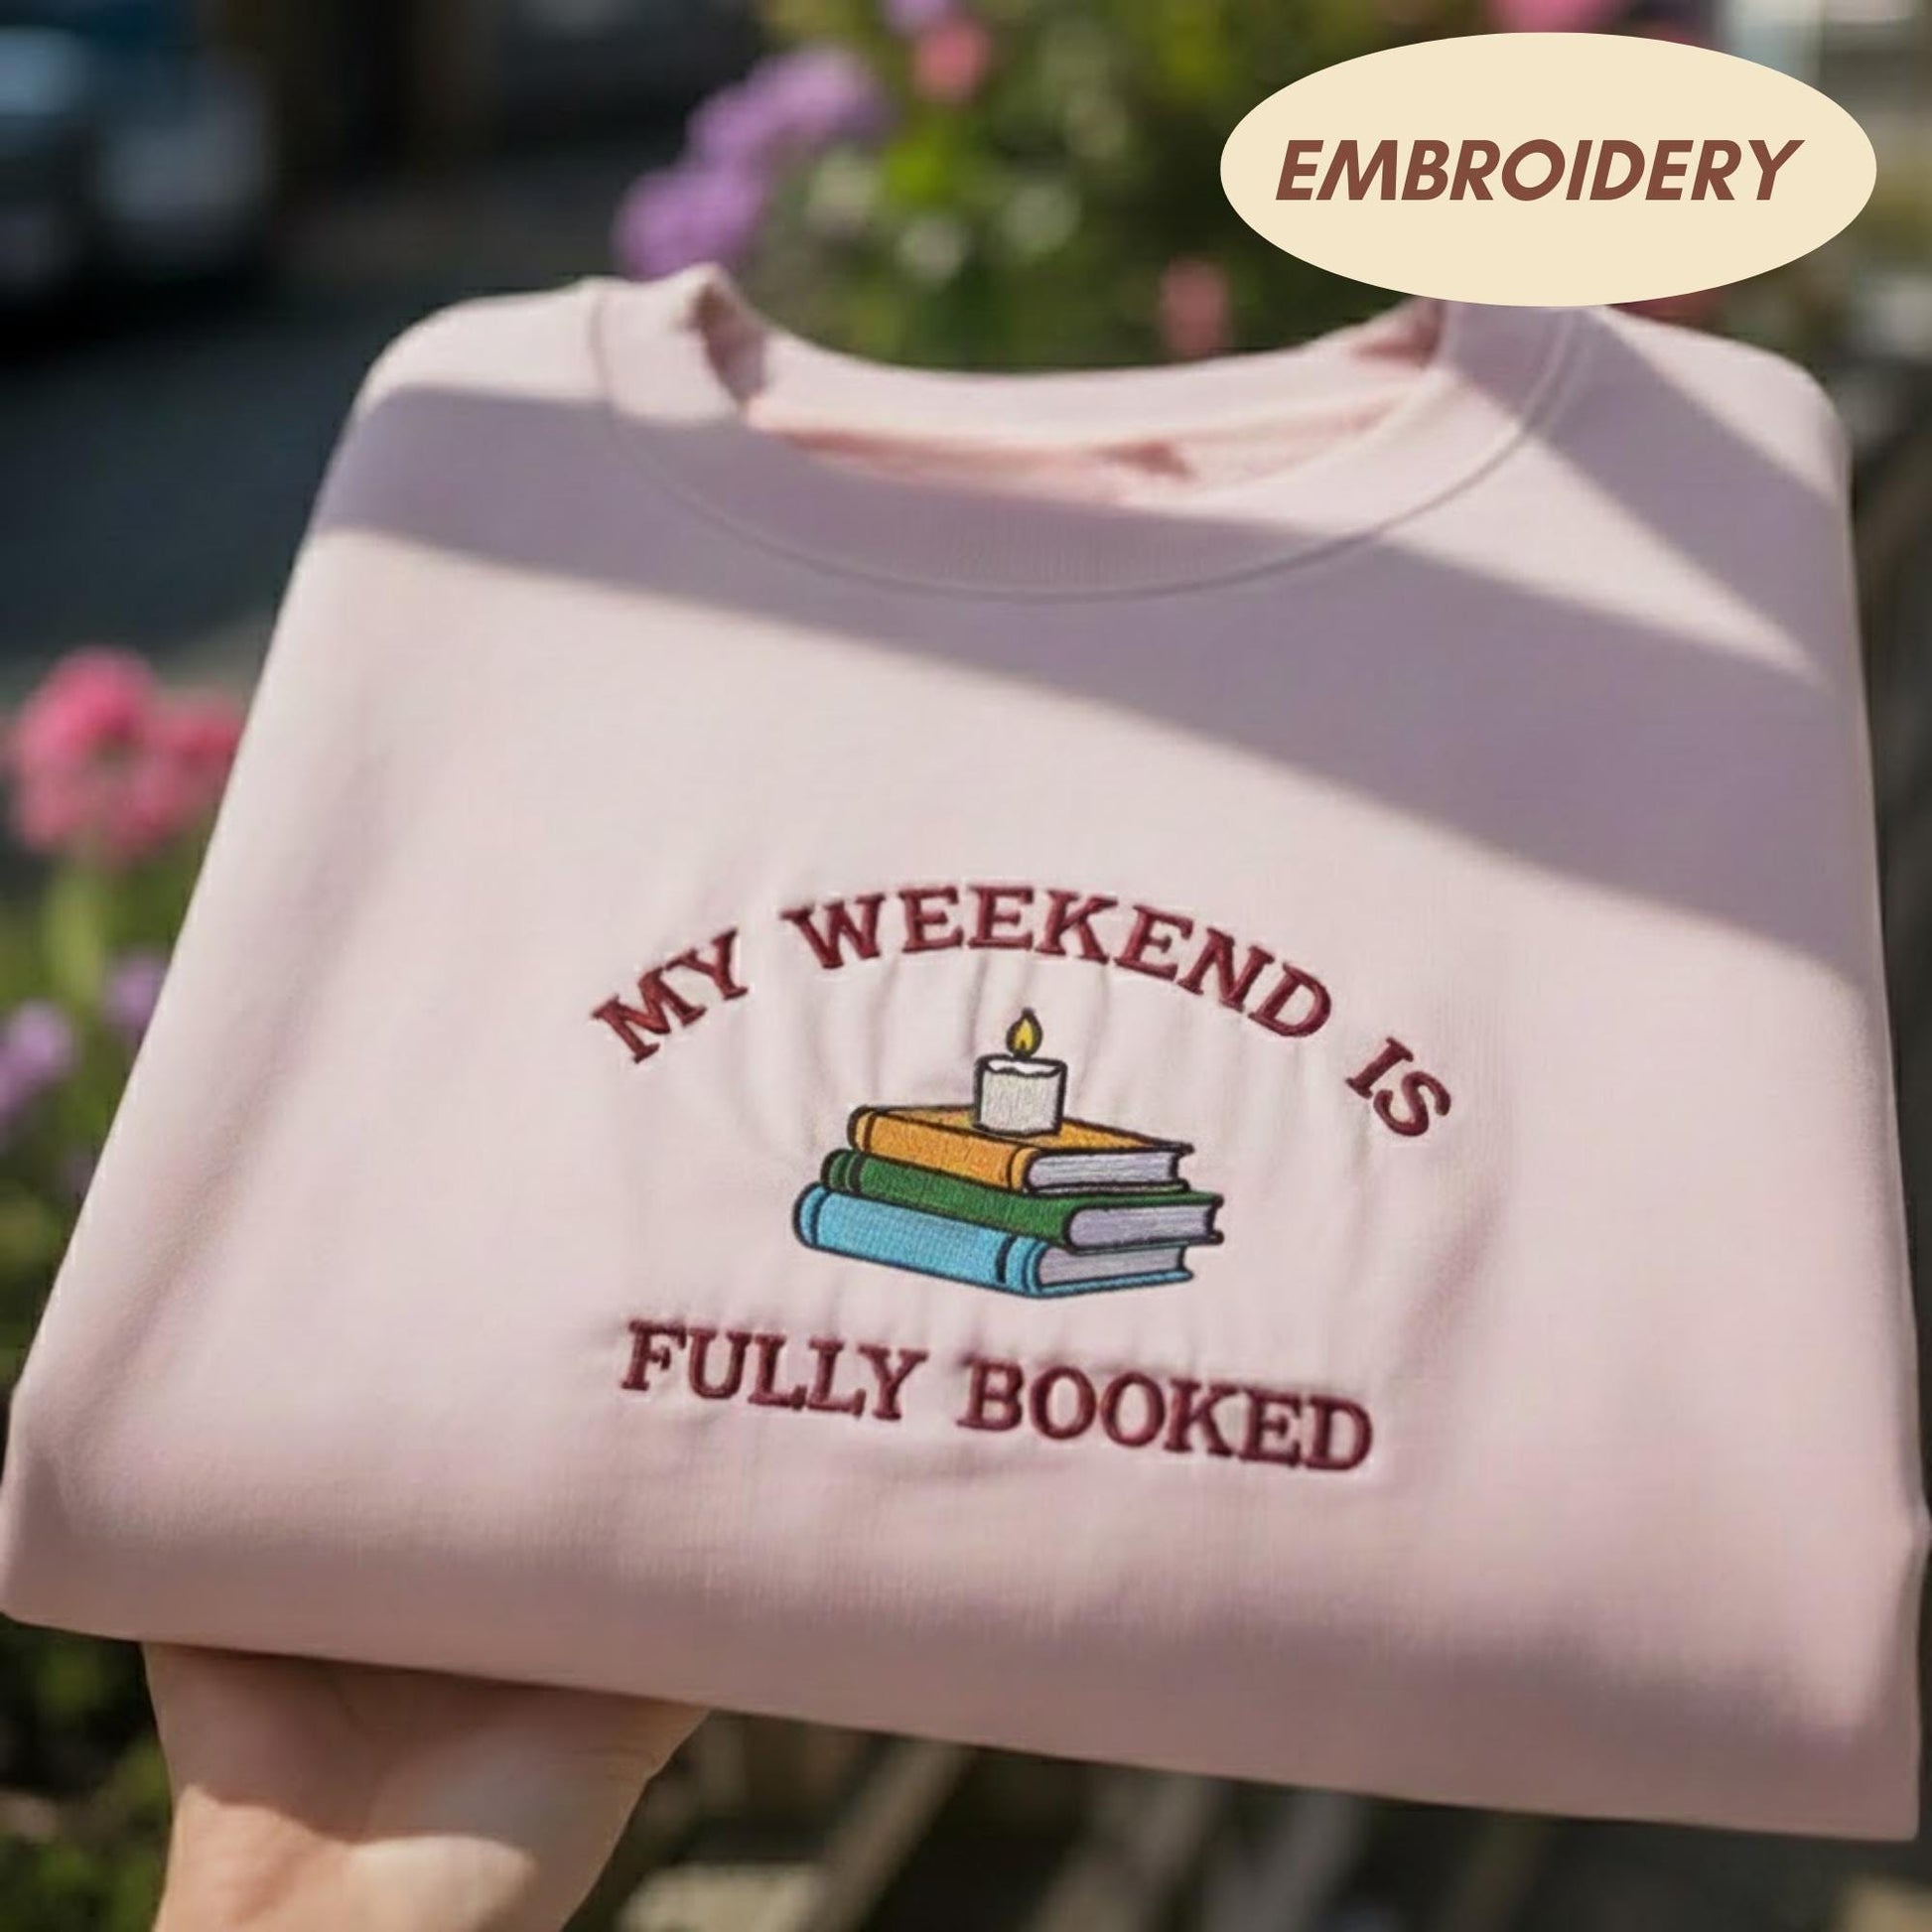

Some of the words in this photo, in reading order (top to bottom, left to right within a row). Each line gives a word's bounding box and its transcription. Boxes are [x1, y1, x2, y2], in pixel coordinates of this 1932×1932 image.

[592, 928, 750, 1063] MY
[782, 885, 1332, 1038] WEEKEND
[1346, 1036, 1452, 1139] IS
[621, 1319, 928, 1422] FULLY
[957, 1353, 1373, 1472] BOOKED
